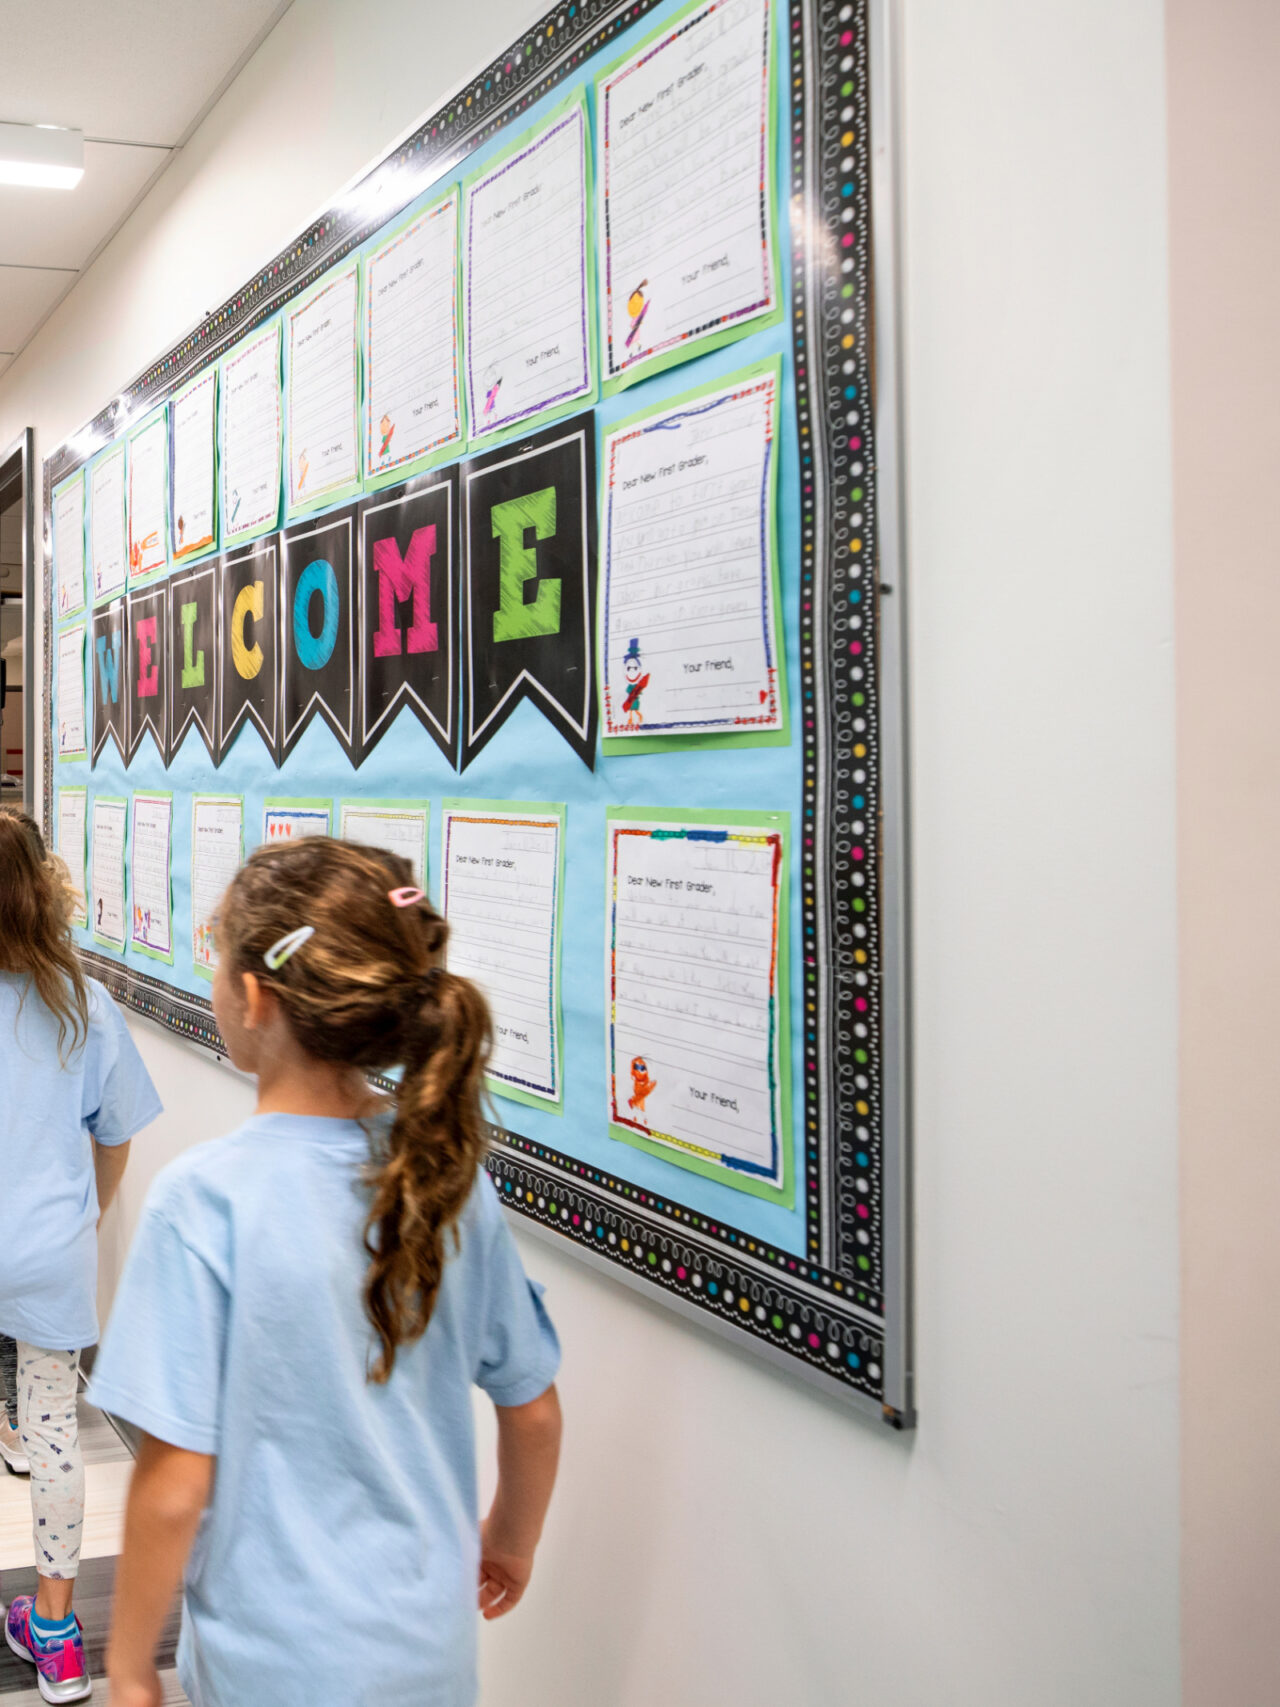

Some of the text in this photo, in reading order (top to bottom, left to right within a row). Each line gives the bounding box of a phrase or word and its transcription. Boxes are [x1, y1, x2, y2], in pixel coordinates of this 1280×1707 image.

[619, 62, 708, 130] Dear New First Grader,
[681, 270, 701, 287] Your
[525, 355, 539, 368] Your
[622, 454, 709, 492] Dear New First Grader,
[96, 486, 562, 706] WELCOME
[683, 656, 735, 674] Your Friend,
[456, 854, 468, 864] Dear
[469, 855, 480, 865] New
[481, 856, 495, 867] First
[627, 874, 716, 897] Dear New First Grader,
[689, 1086, 740, 1114] Your Friend,
